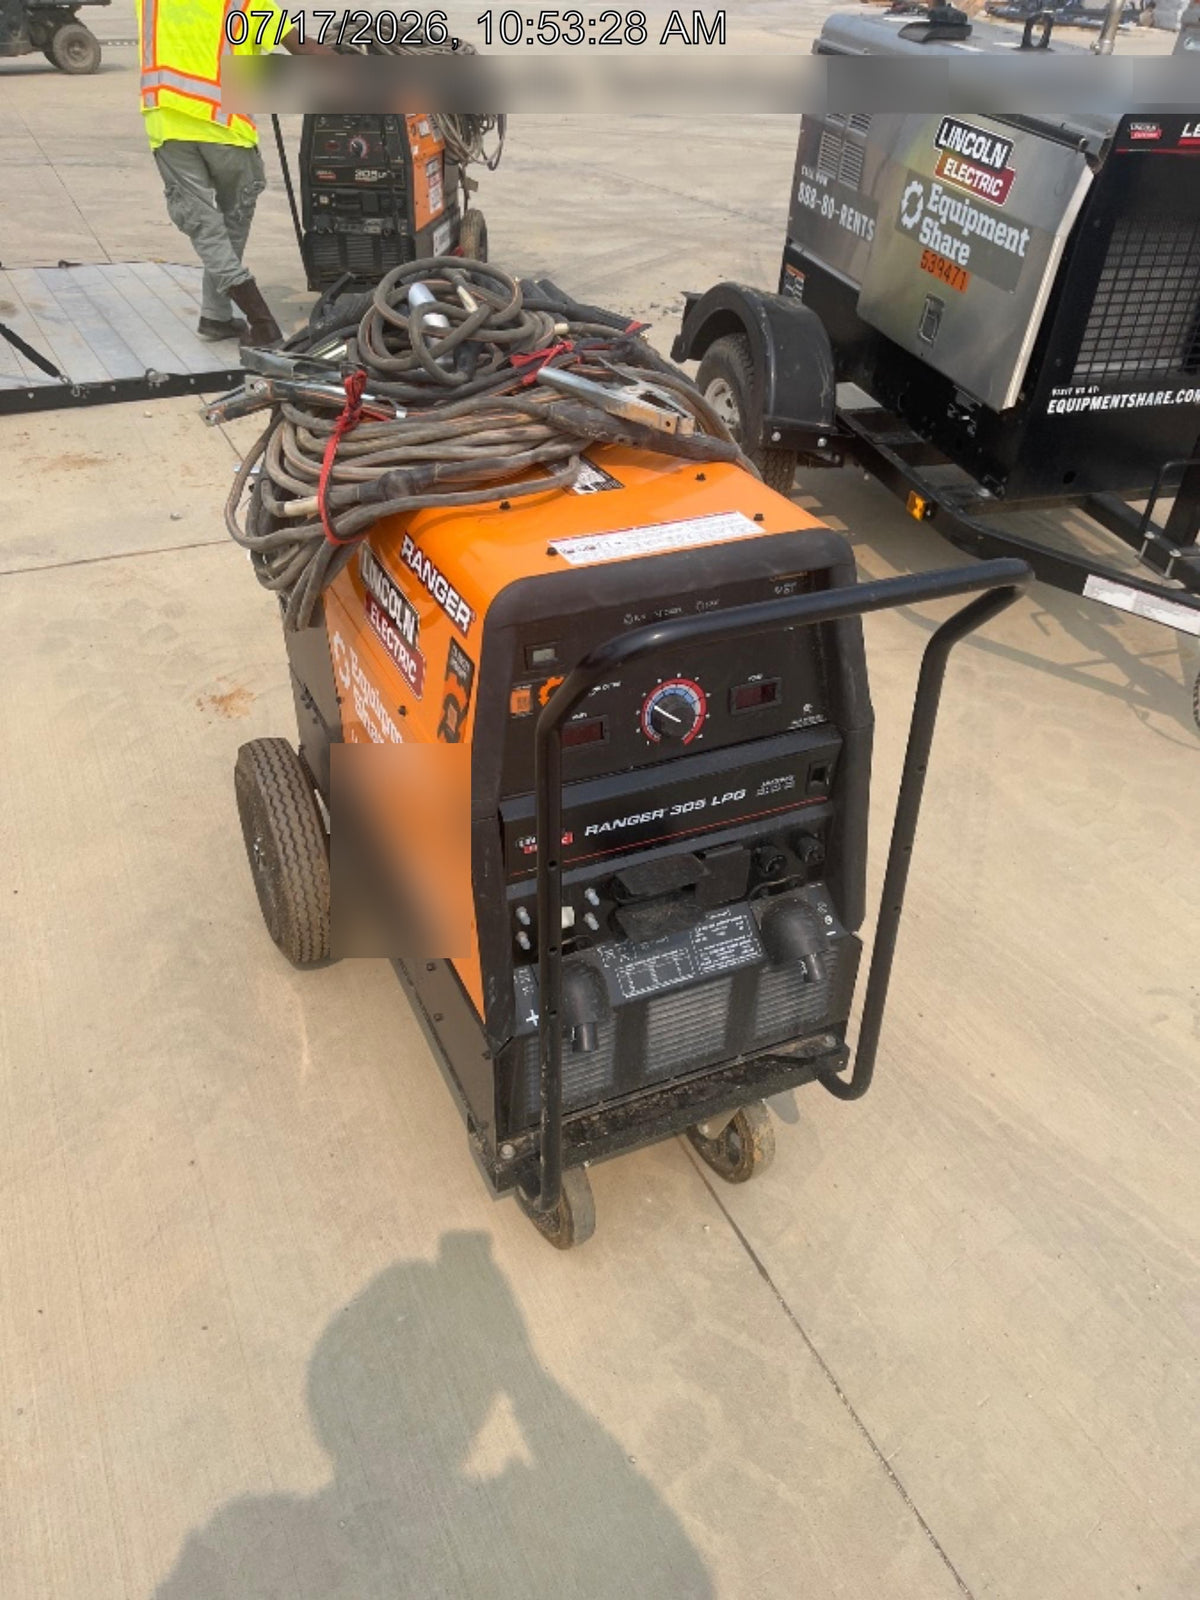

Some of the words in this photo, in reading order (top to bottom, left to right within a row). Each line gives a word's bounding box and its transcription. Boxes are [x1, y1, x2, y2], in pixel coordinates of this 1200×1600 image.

[938, 121, 1008, 169] LINCOLN
[943, 157, 1003, 197] ELECTRIC
[797, 180, 876, 242] 888-80-RENTS
[918, 215, 971, 267] Share
[927, 182, 1030, 258] Equipment
[361, 549, 415, 650] LINCOLN
[402, 534, 472, 633] RANGER
[370, 606, 417, 684] ELECTRIC
[585, 808, 664, 837] RANGER
[670, 799, 706, 817] 305
[711, 788, 748, 806] LPG
